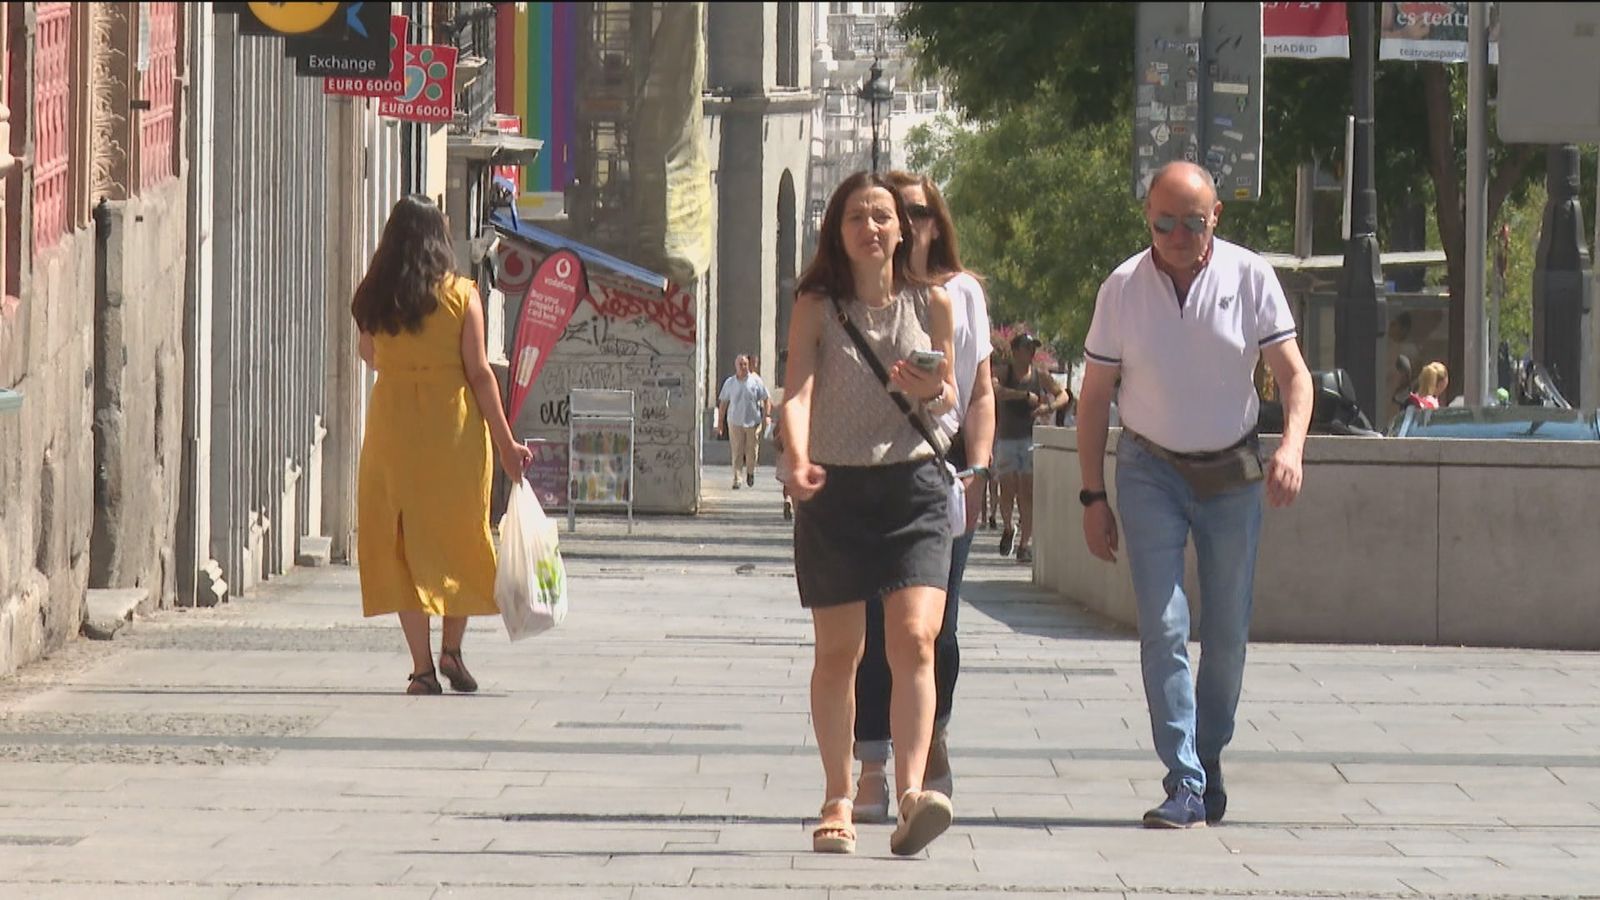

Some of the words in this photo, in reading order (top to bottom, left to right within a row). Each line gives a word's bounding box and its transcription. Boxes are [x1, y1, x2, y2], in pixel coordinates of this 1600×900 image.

[1396, 12, 1417, 26] es
[1422, 11, 1468, 26] teatr
[1273, 43, 1318, 54] MADRID
[308, 54, 377, 73] Exchange
[328, 80, 364, 92] EURO
[366, 80, 402, 92] 6000
[381, 103, 414, 116] EURO
[417, 104, 450, 117] 6000
[544, 276, 576, 293] vodafone
